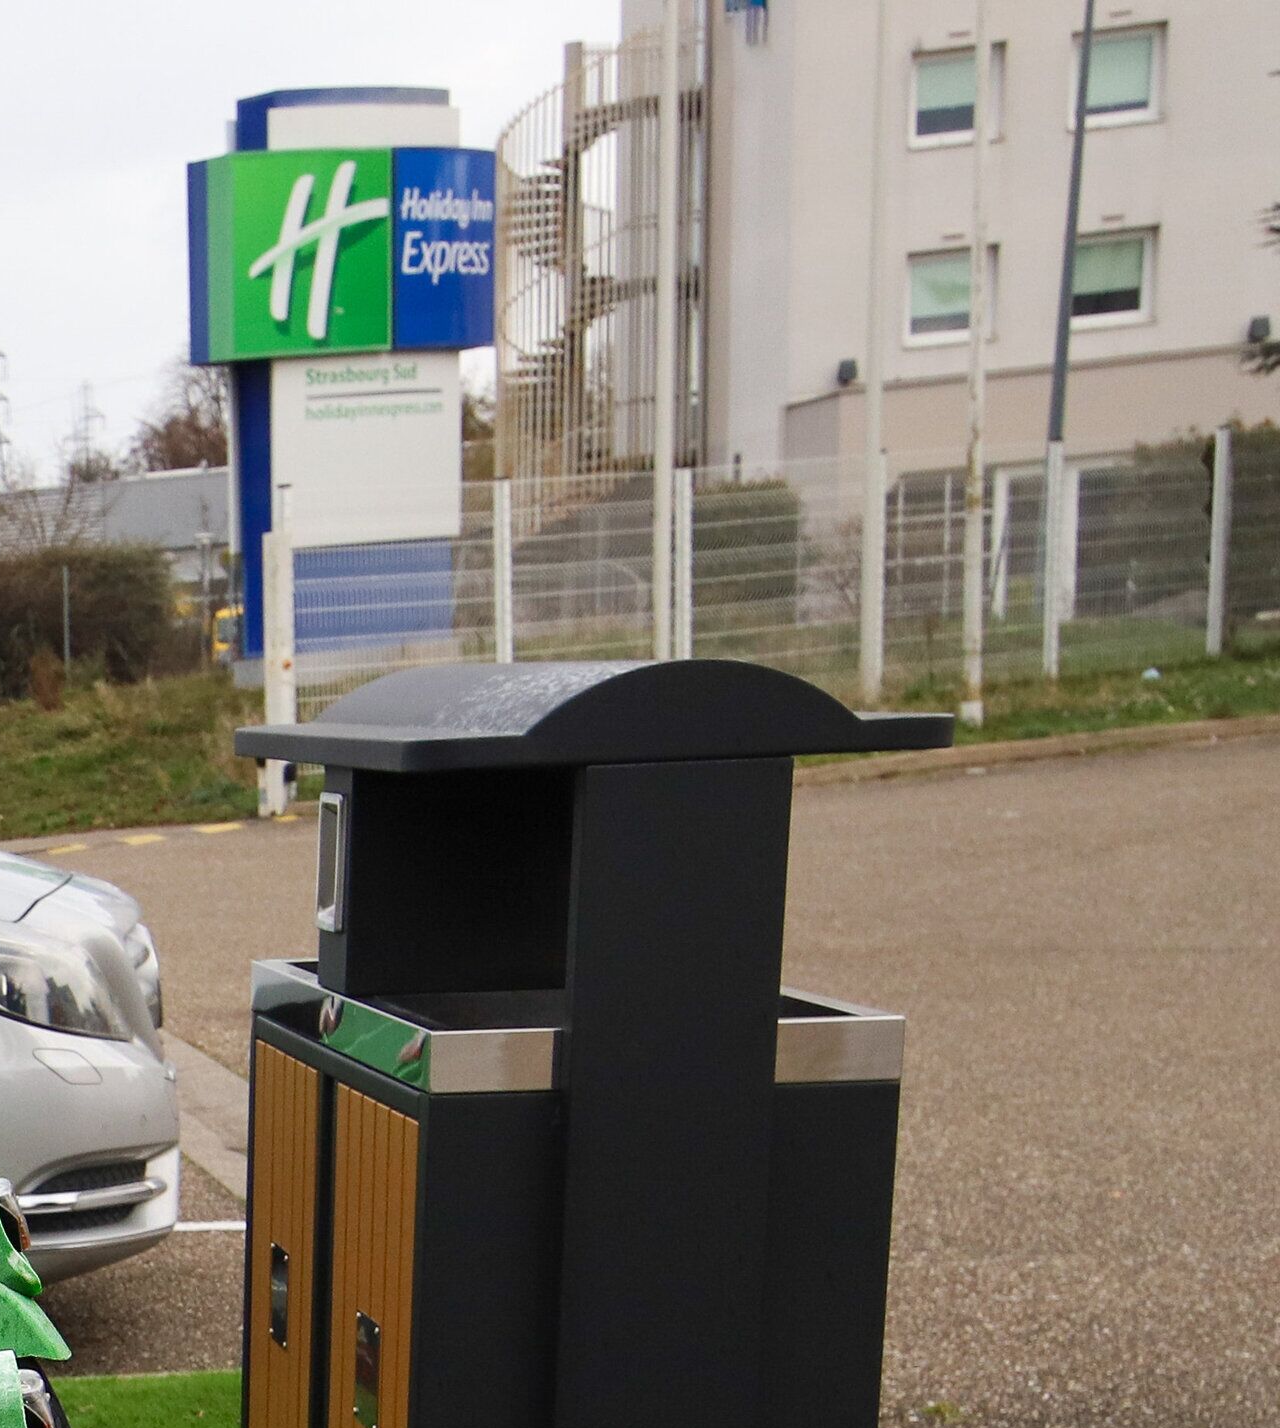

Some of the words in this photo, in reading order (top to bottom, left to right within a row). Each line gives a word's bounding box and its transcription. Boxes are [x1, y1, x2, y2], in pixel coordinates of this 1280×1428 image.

[401, 187, 470, 229] Holiday
[471, 188, 493, 221] Inn
[401, 230, 490, 286] Express
[305, 366, 390, 386] Strasbourg
[393, 363, 418, 380] Sud
